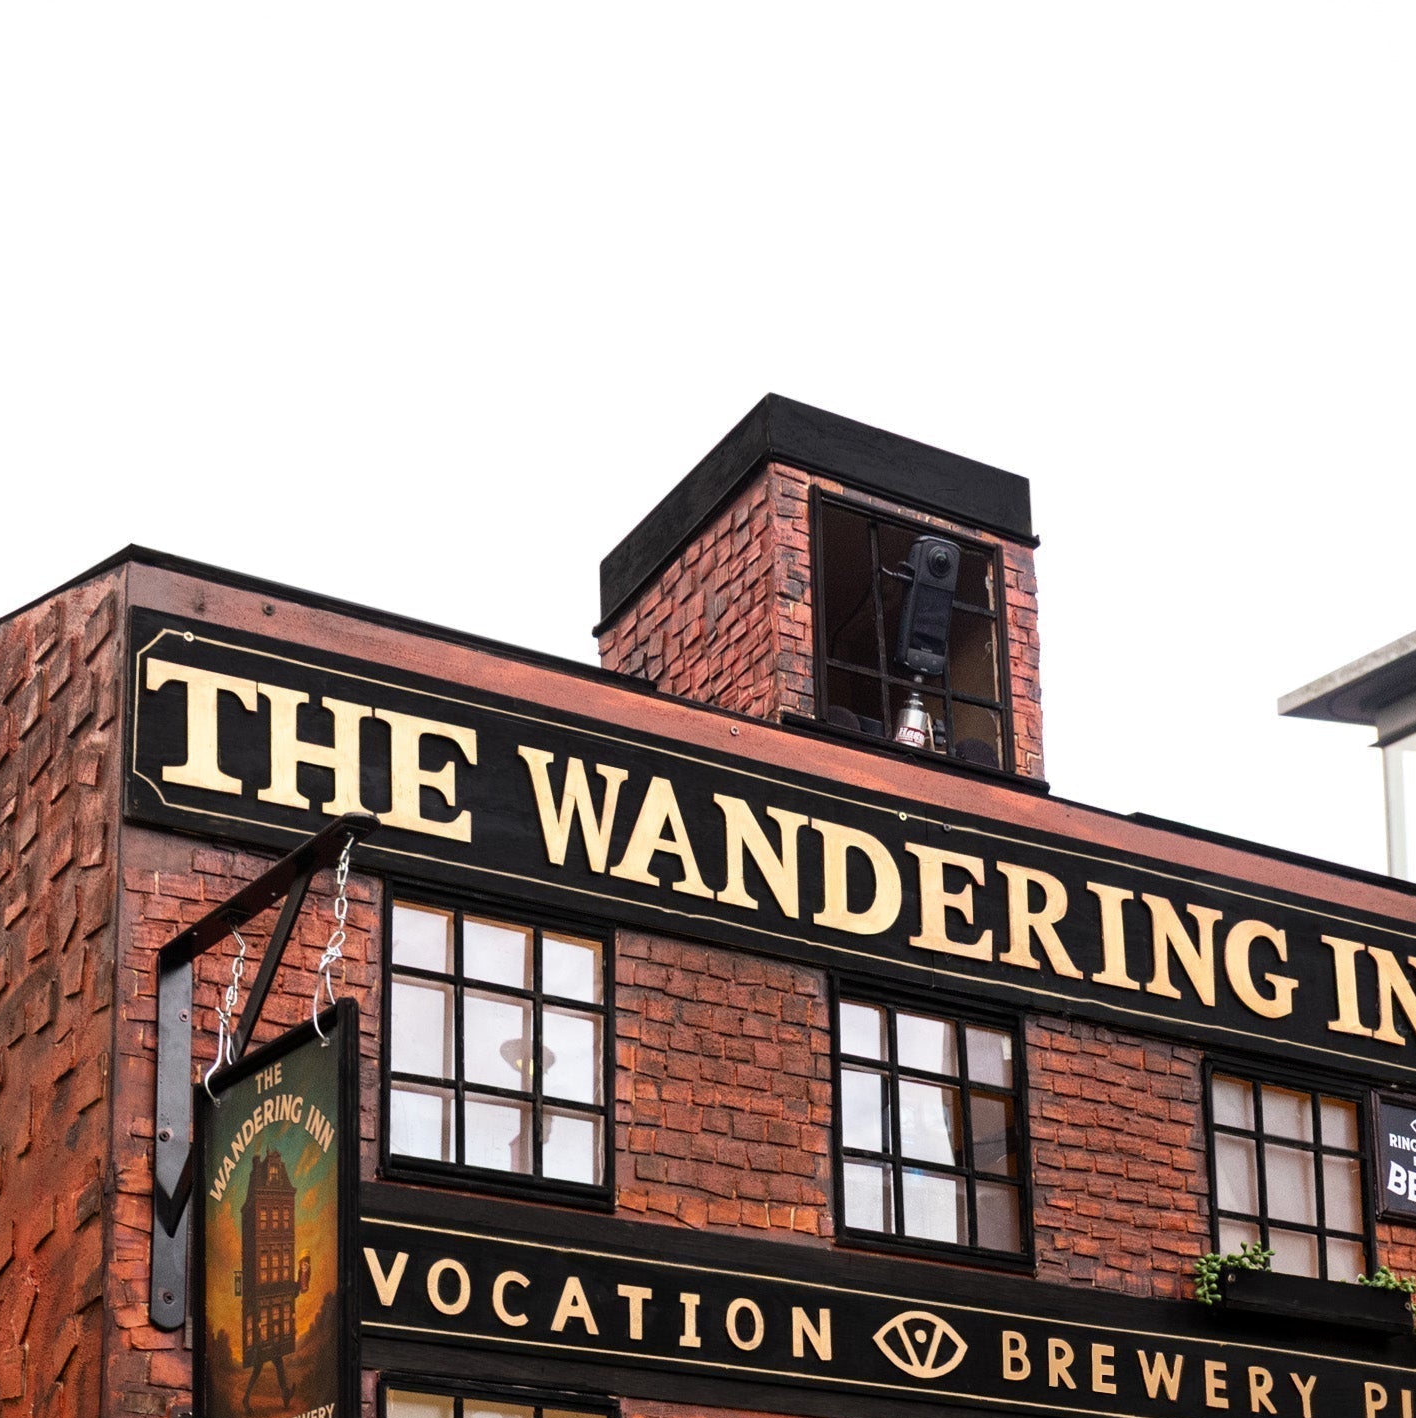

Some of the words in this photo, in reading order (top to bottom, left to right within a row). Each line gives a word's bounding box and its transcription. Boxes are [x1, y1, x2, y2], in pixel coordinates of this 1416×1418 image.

[146, 657, 478, 843] THE
[517, 744, 1300, 1020] WANDERING
[255, 1062, 282, 1094] THE
[209, 1094, 304, 1202] WANDERING
[304, 1104, 336, 1153] INN
[363, 1247, 832, 1362] VOCATION
